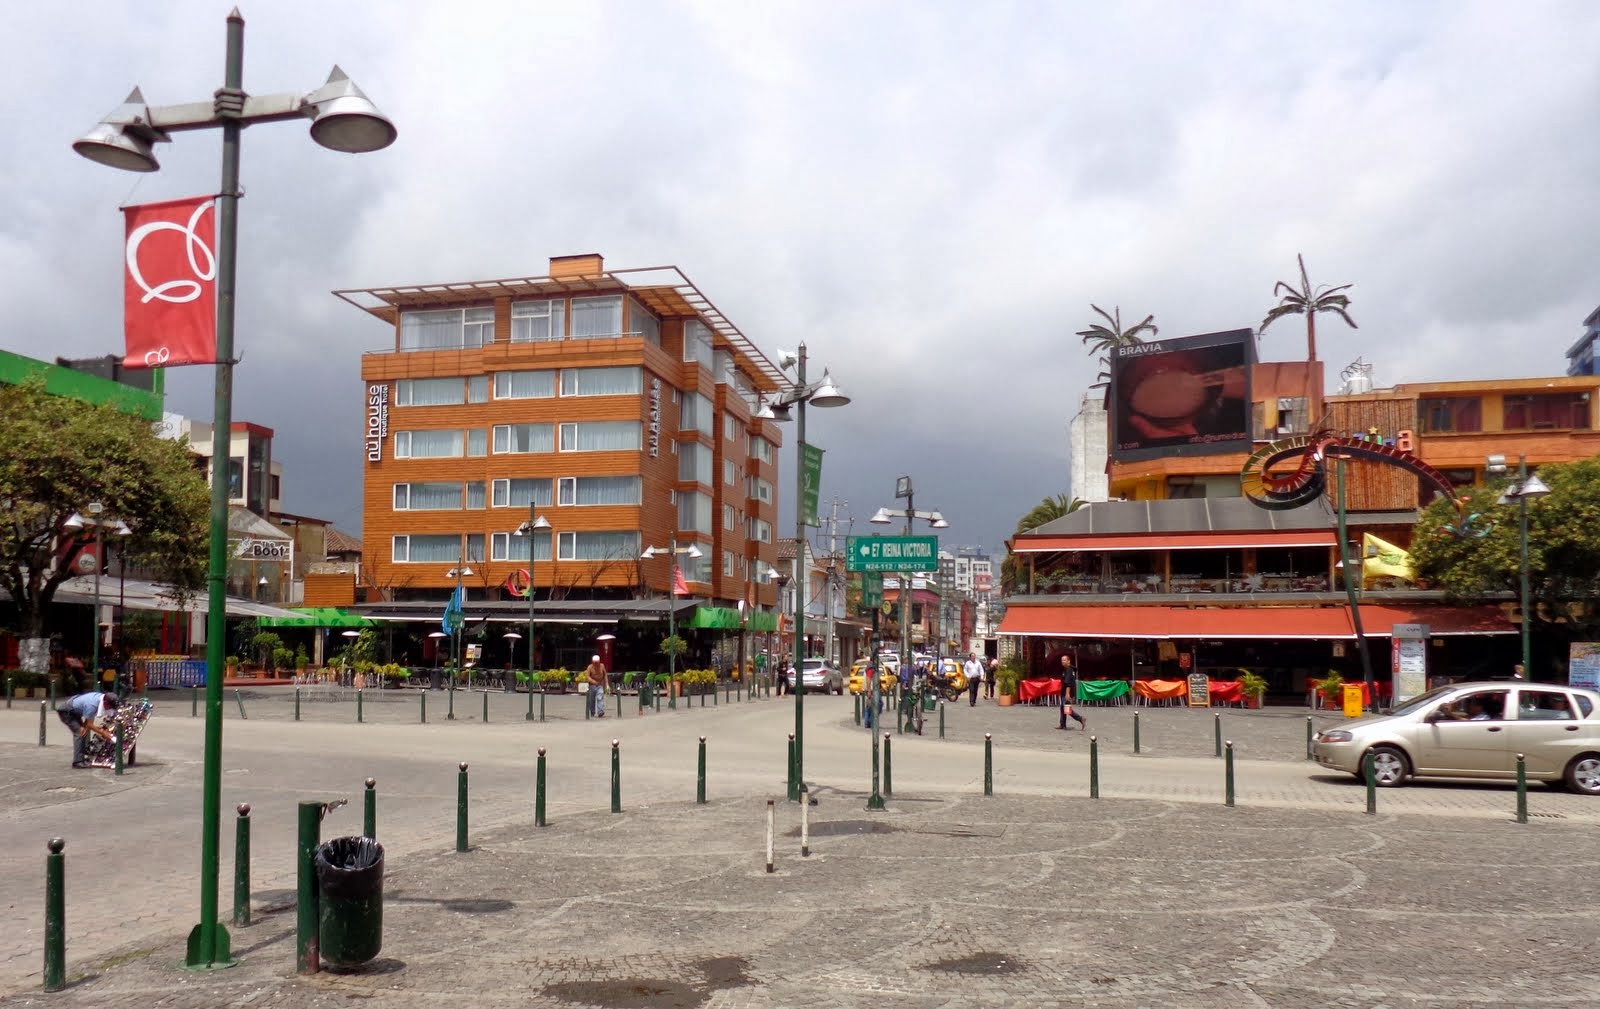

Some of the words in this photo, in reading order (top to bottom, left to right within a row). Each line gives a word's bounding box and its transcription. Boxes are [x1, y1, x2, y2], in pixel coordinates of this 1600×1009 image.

[1119, 343, 1162, 356] BRAVIA
[381, 384, 389, 403] hotel
[366, 385, 380, 438] house
[381, 405, 389, 438] boutique
[365, 441, 380, 462] nü
[253, 544, 285, 557] Boot
[871, 542, 880, 558] E7
[882, 542, 902, 558] REINA
[902, 542, 932, 558] VICTORIA
